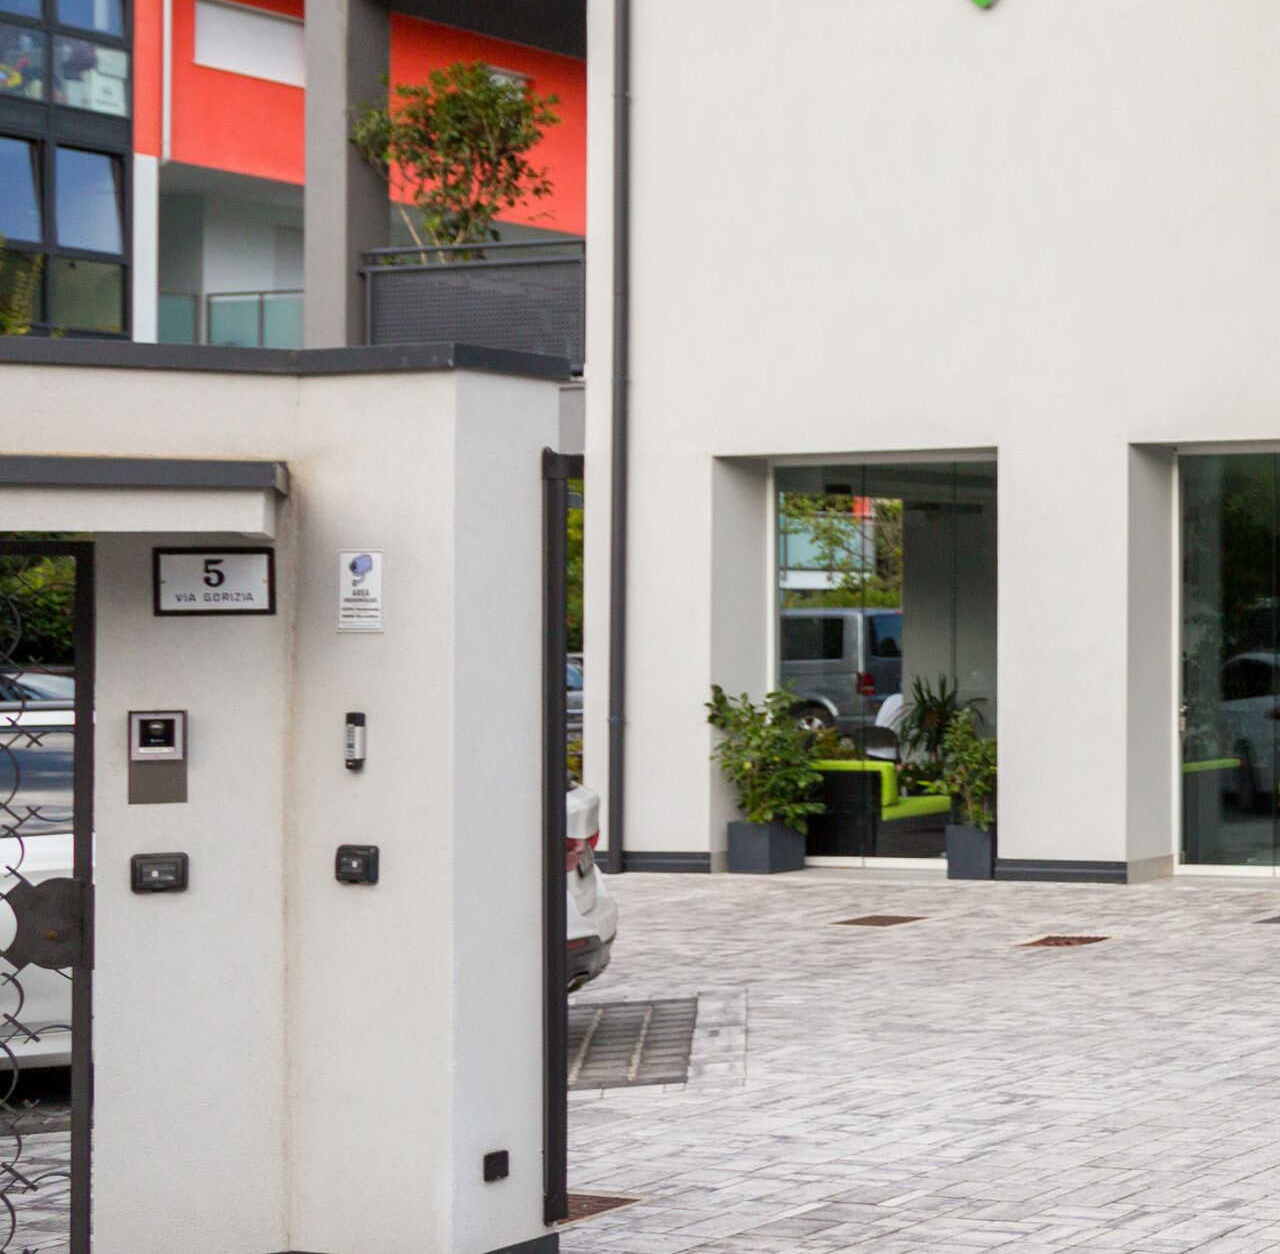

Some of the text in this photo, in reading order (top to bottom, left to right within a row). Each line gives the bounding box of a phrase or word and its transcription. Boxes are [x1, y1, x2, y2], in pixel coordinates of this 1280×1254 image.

[203, 558, 225, 587] 5
[175, 591, 254, 603] VIA GORIZIA
